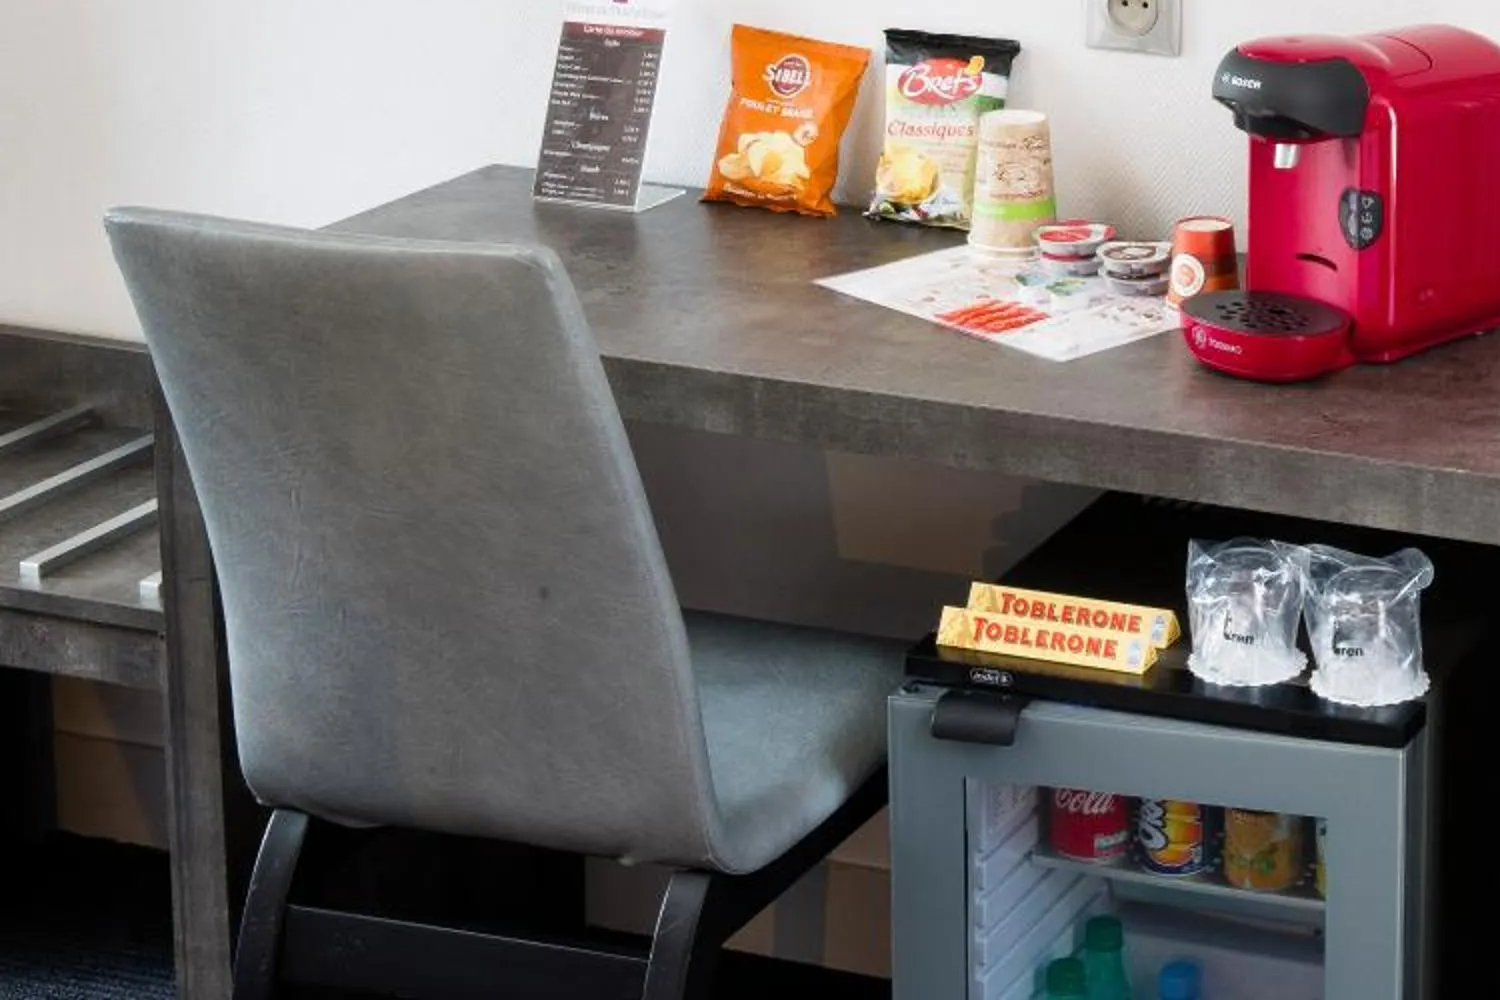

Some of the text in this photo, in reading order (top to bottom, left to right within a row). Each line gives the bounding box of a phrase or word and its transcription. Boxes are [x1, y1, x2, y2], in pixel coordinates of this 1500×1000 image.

[887, 119, 976, 140] Classiques
[1001, 592, 1142, 633] TOBLERONE
[972, 616, 1119, 659] TOBLERONE
